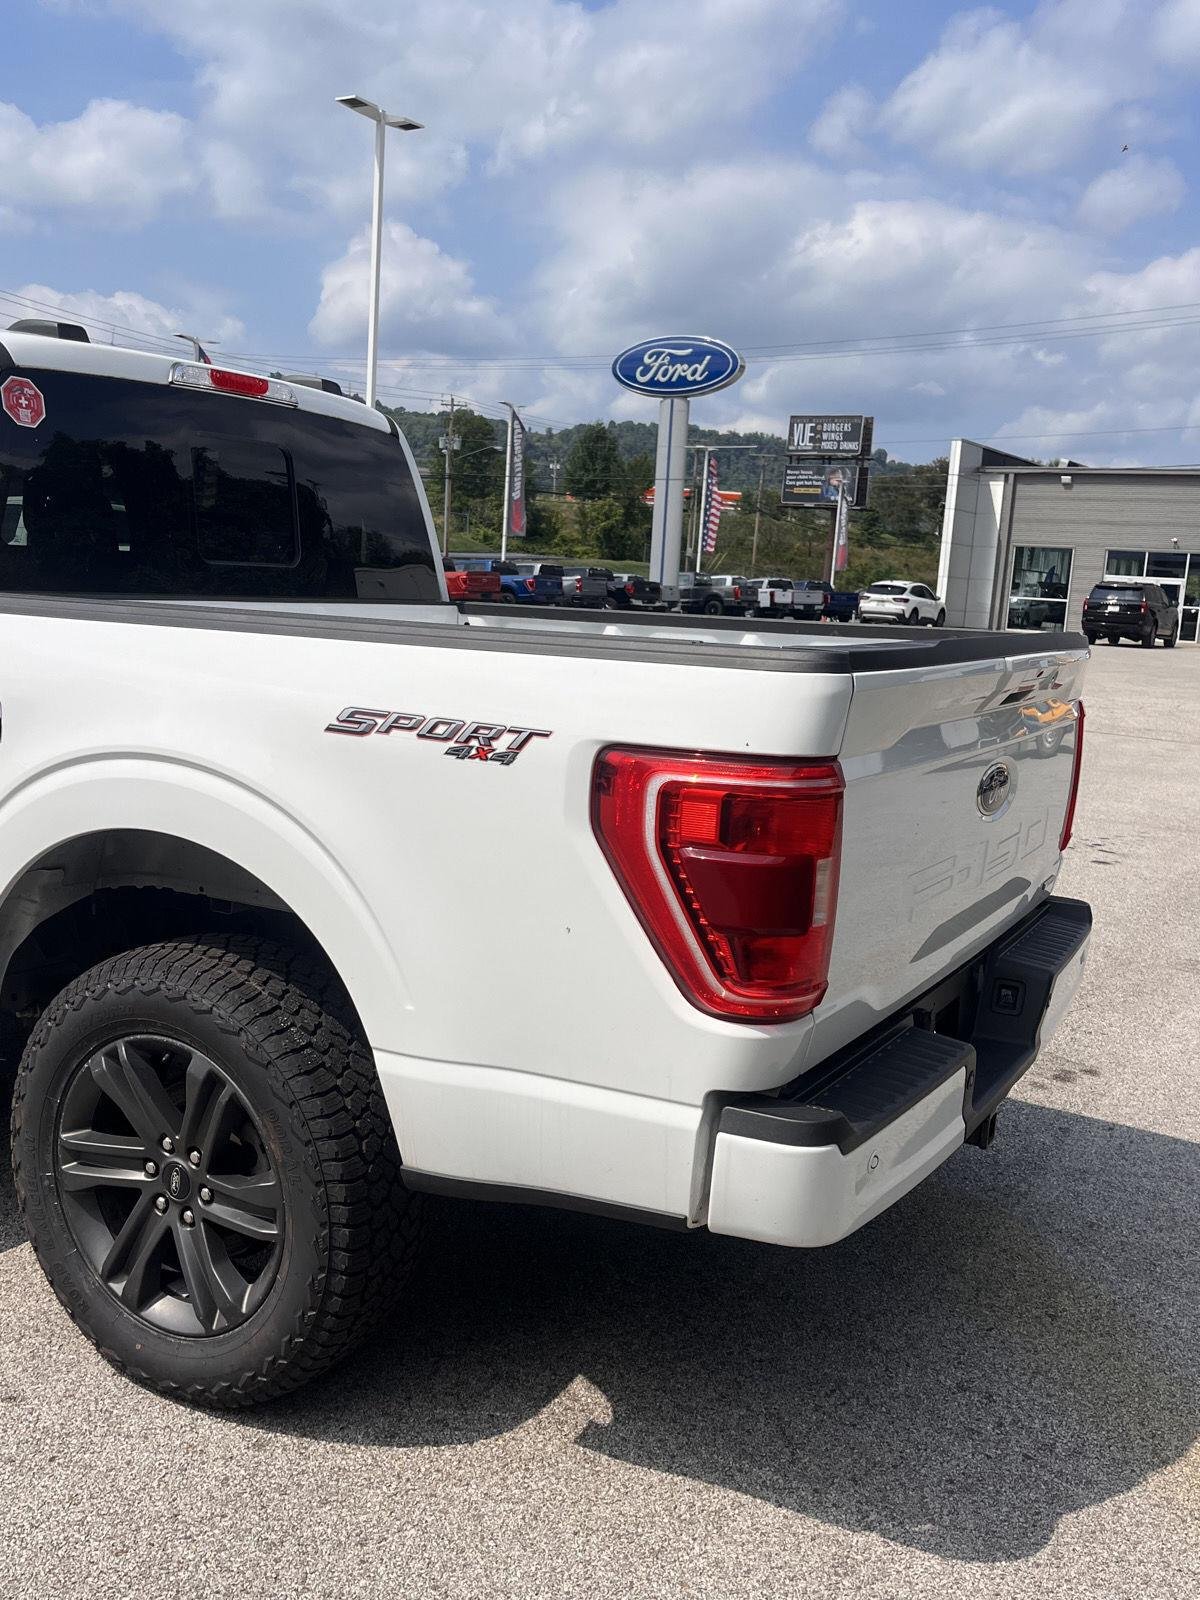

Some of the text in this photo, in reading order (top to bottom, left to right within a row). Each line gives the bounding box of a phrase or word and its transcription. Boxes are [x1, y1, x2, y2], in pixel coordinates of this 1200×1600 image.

[636, 348, 711, 382] Ford
[793, 423, 816, 446] VUE
[823, 423, 852, 432] BURGERS
[821, 432, 843, 441] WINGS
[820, 441, 838, 450] MIXED
[839, 442, 859, 451] DRINKS
[324, 706, 553, 753] SPORT
